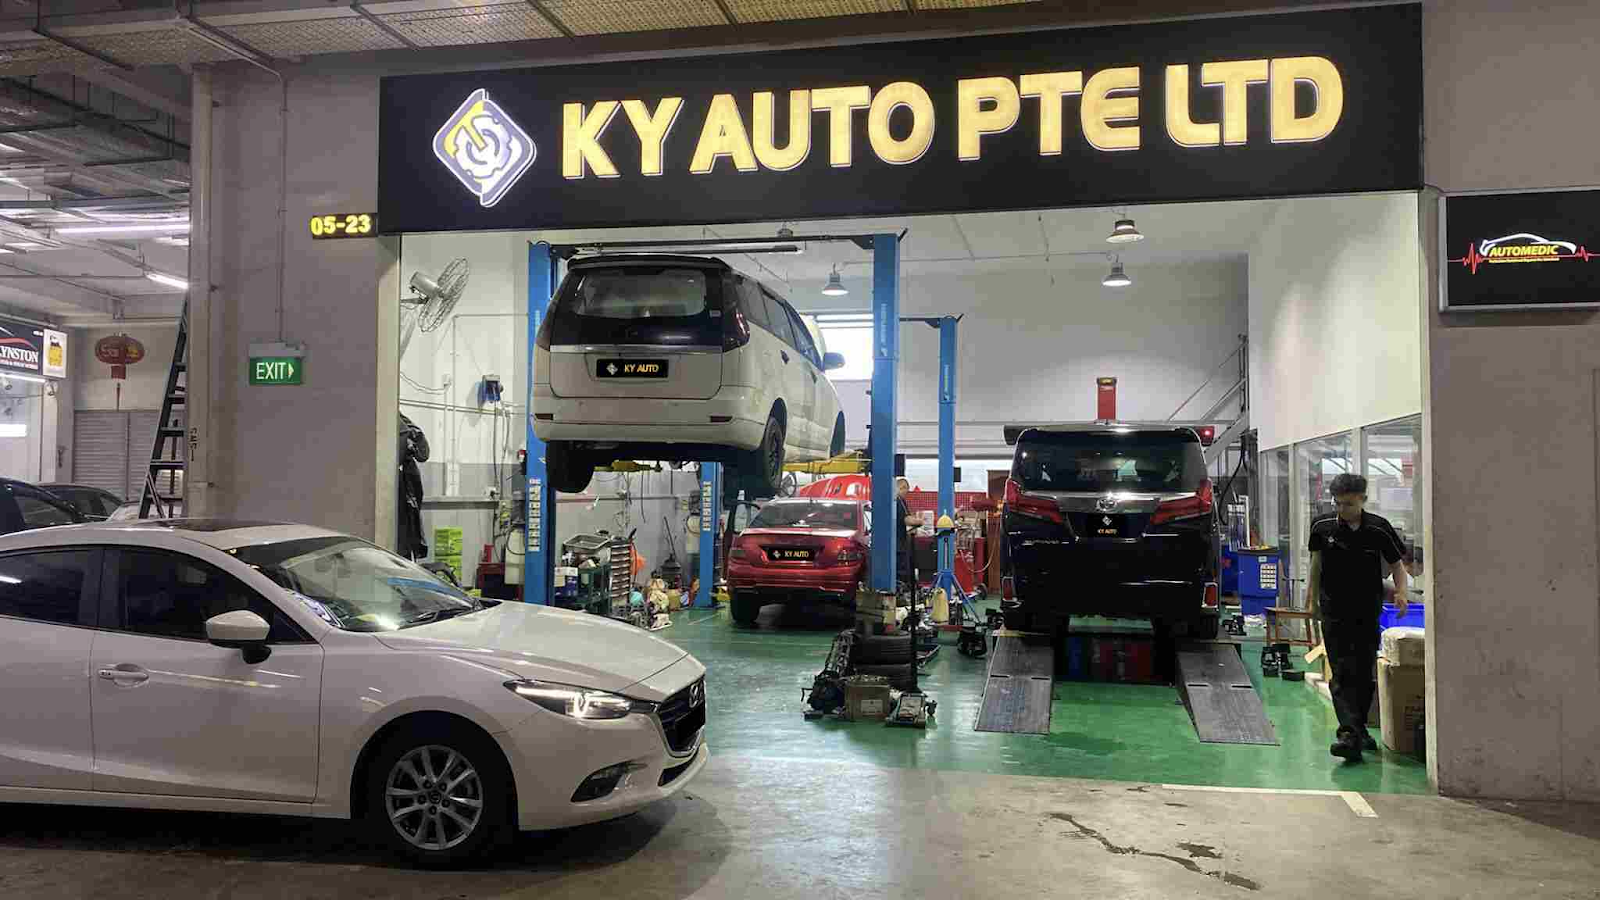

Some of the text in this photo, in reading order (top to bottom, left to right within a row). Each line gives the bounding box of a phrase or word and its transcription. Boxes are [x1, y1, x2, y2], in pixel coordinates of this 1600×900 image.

[562, 56, 1344, 180] KY AUTO PTE LTD
[310, 214, 372, 236] 05-23
[1489, 245, 1559, 257] AUTOMEDIC
[0, 345, 39, 363] YNSTON
[256, 362, 287, 380] EXIT
[624, 364, 659, 373] KY AUTO
